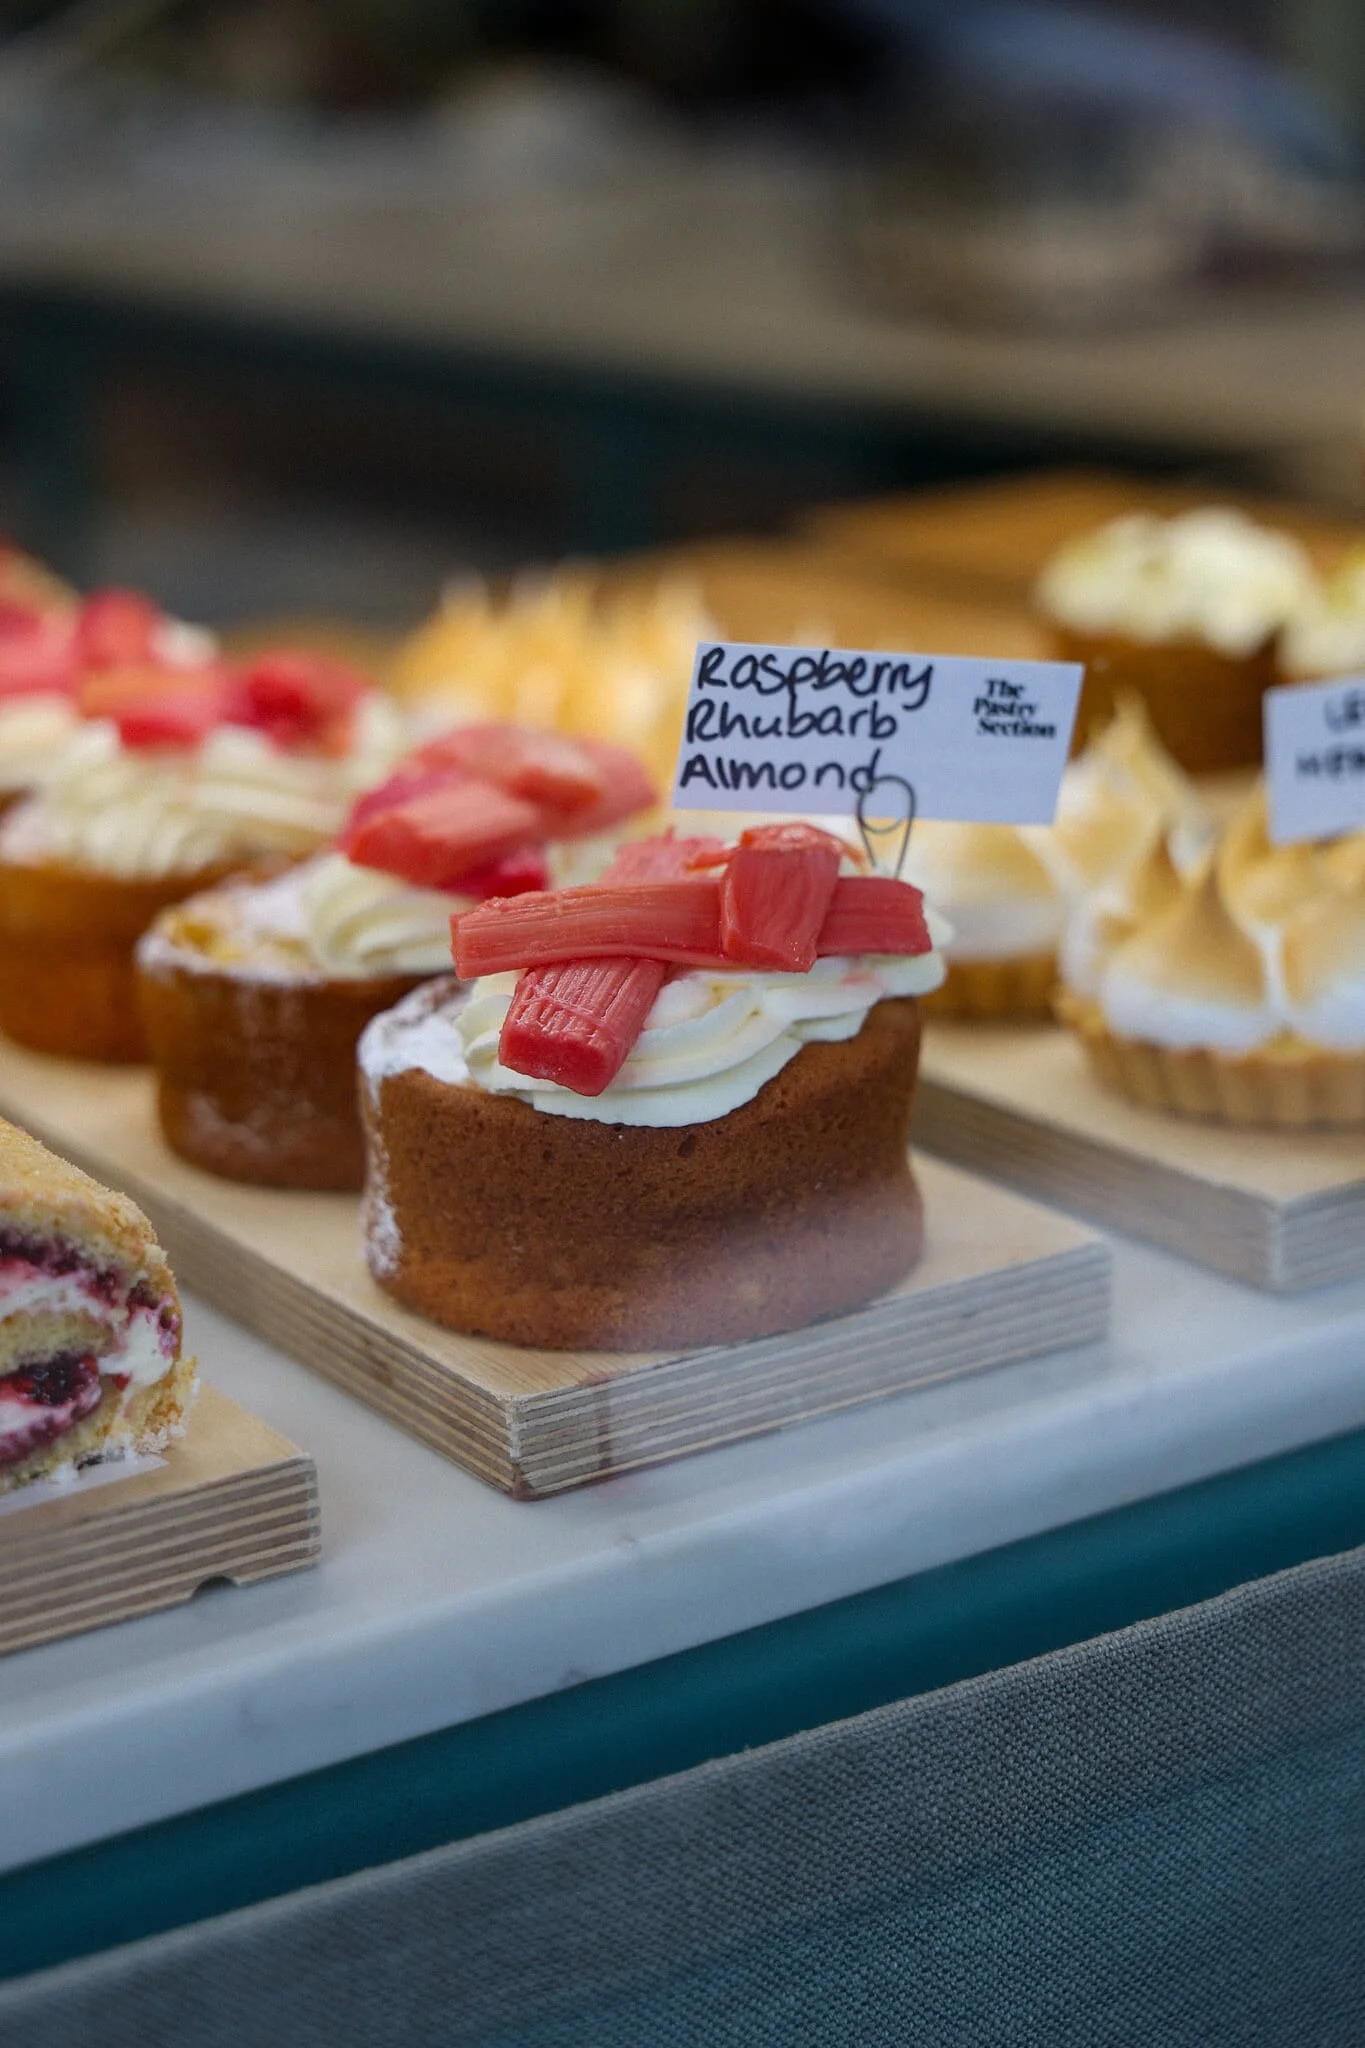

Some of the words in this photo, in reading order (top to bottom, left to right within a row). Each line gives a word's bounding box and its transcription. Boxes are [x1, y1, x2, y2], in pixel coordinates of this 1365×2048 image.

[697, 647, 933, 711] Raspberry
[985, 678, 1024, 699] The
[687, 698, 898, 743] Rhubarb
[974, 698, 1036, 718] Pastry
[978, 719, 1056, 739] Section
[680, 748, 882, 794] Almond
